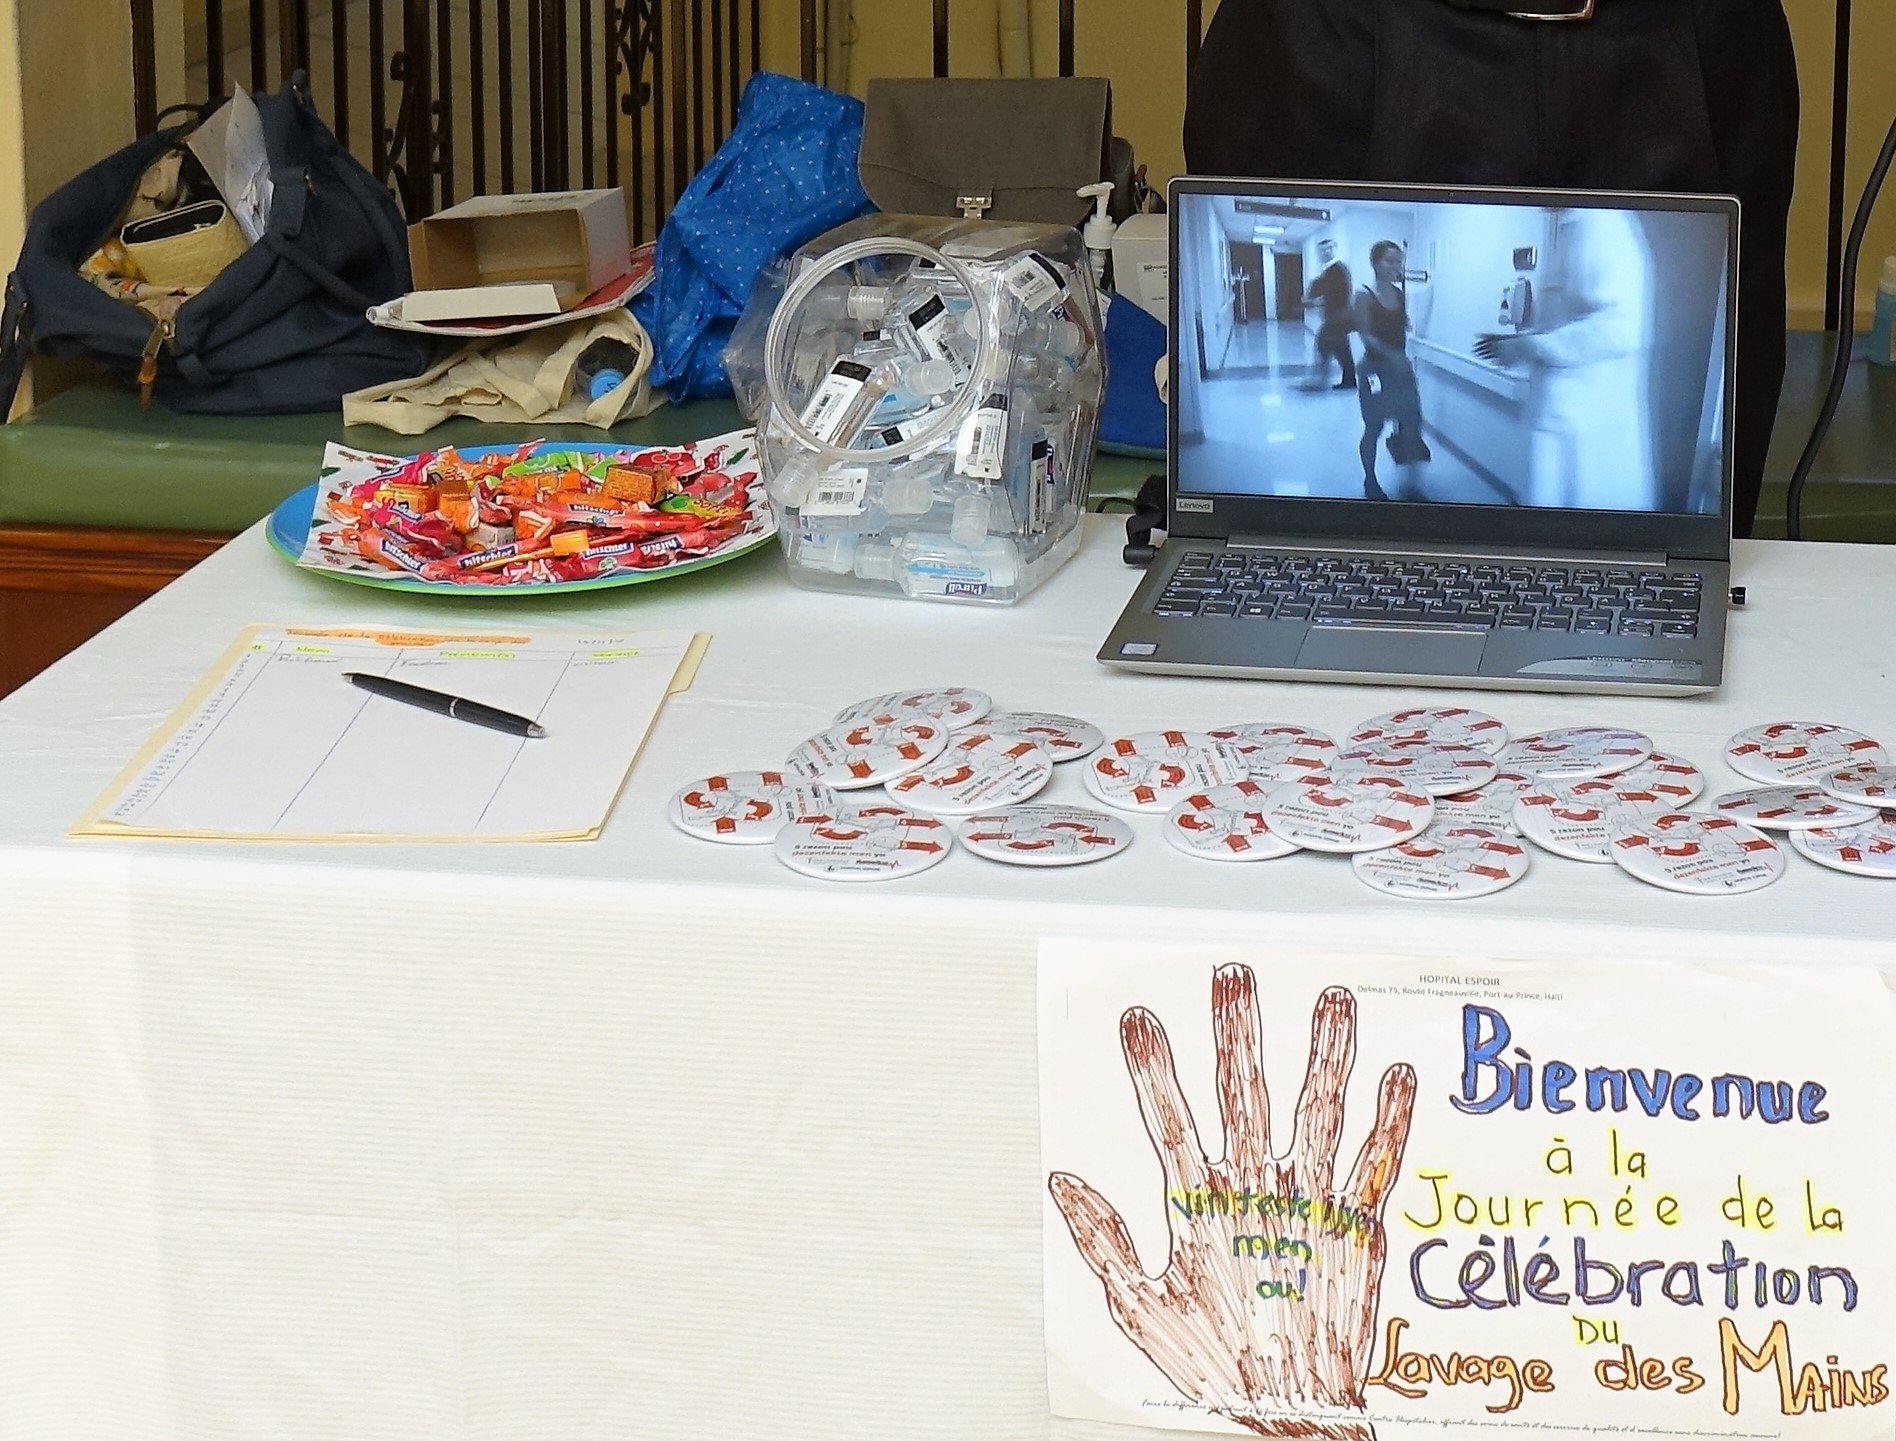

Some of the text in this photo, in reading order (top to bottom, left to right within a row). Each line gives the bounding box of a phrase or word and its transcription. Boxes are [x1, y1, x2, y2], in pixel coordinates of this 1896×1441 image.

[1179, 501, 1211, 510] Lenovo
[1403, 986, 1426, 995] Route
[1419, 974, 1501, 987] HOPITAL ESPOIR
[1449, 1003, 1829, 1124] Bienvenue
[1612, 1130, 1646, 1178] la
[1404, 1173, 1843, 1232] Journée de la
[1232, 1233, 1313, 1263] men
[1366, 1317, 1555, 1414] Lavage
[1595, 1343, 1705, 1394] des
